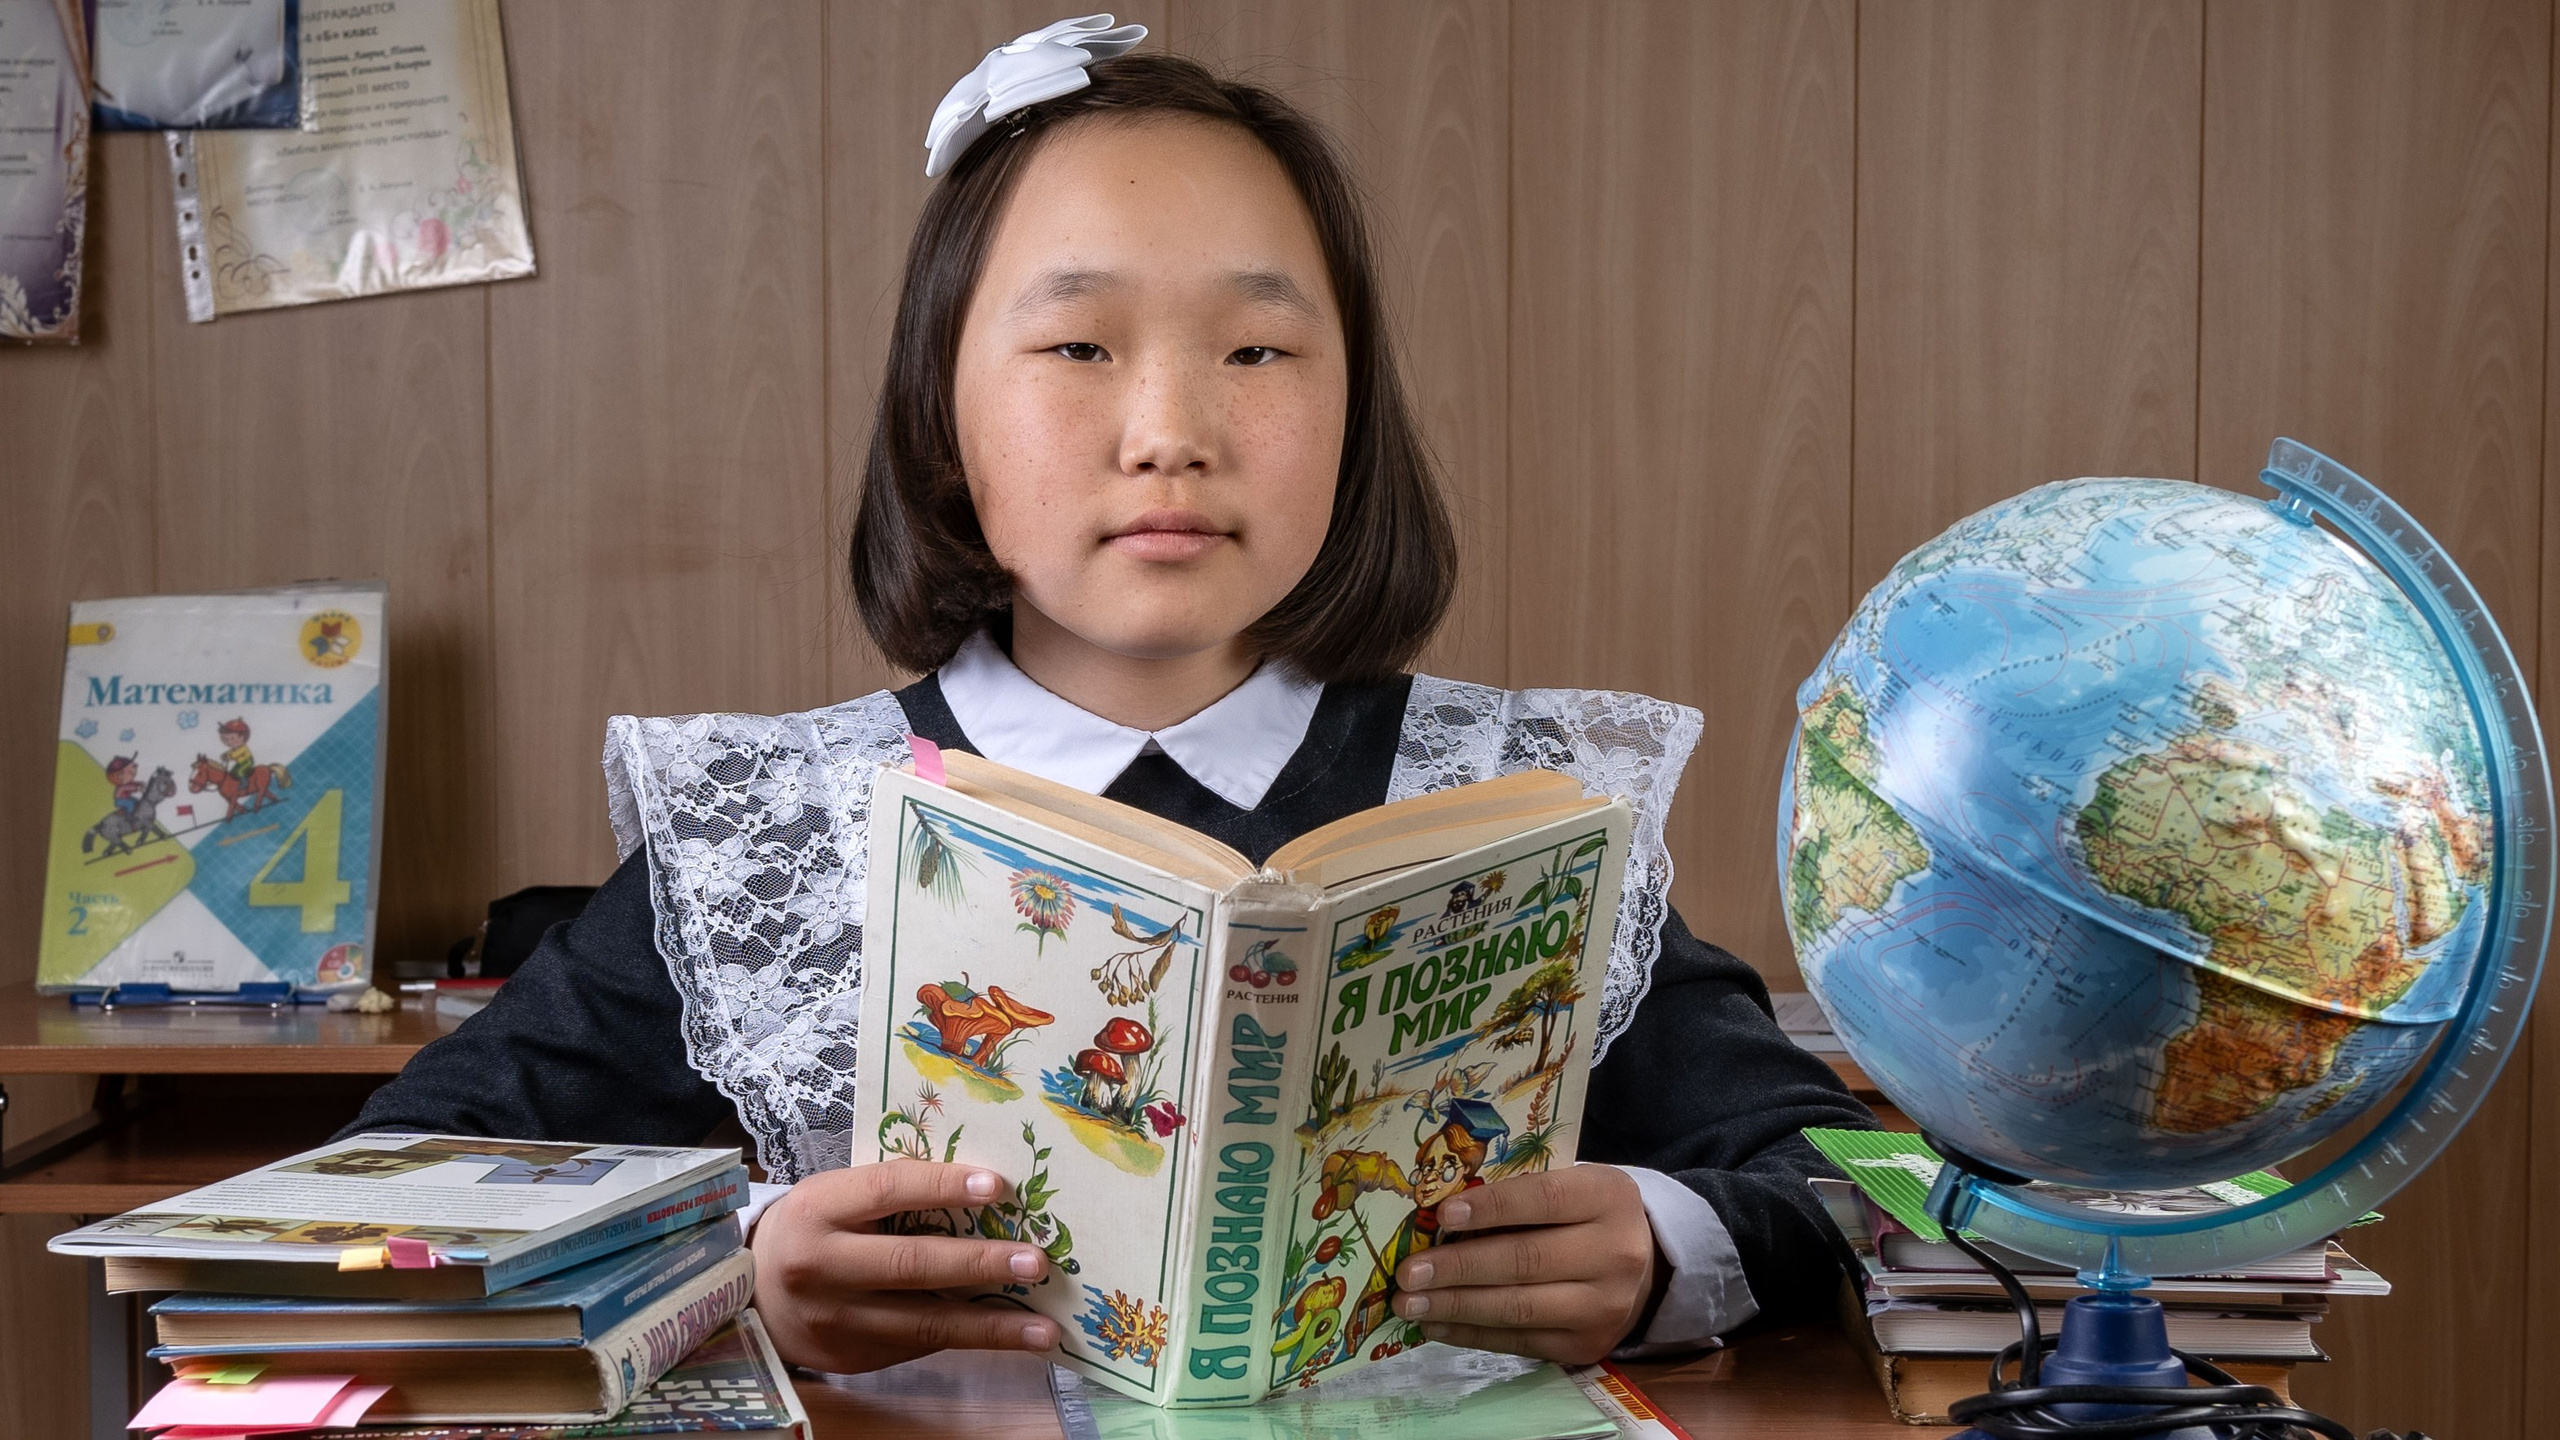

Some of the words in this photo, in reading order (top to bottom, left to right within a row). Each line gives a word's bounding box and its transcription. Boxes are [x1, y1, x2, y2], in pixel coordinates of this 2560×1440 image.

[342, 27, 379, 39] класс
[2354, 499, 2382, 524] 80
[2407, 547, 2433, 573] 70
[85, 674, 334, 707] Математика
[249, 788, 351, 934] 4
[69, 891, 119, 905] Часть
[67, 906, 89, 937] 2
[1412, 896, 1512, 944] РАСТЕНИЯ
[1331, 972, 1371, 1036] Я
[1378, 911, 1570, 1018] ПОЗНАЮ
[1226, 989, 1299, 1005] РАСТЕНИЯ
[1389, 982, 1493, 1056] МИР
[1223, 1013, 1288, 1126] МИР
[631, 1216, 643, 1229] ПО
[646, 1199, 694, 1224] РАЗРАБОТКИ
[560, 1220, 631, 1257] ИЗОБРАЗИТЕЛЬНОМУ
[1200, 1140, 1274, 1336] ПОЗНАЮ
[1189, 1344, 1250, 1382] Я
[629, 1400, 768, 1414] ГОВ
[630, 1390, 764, 1403] ЧИТ
